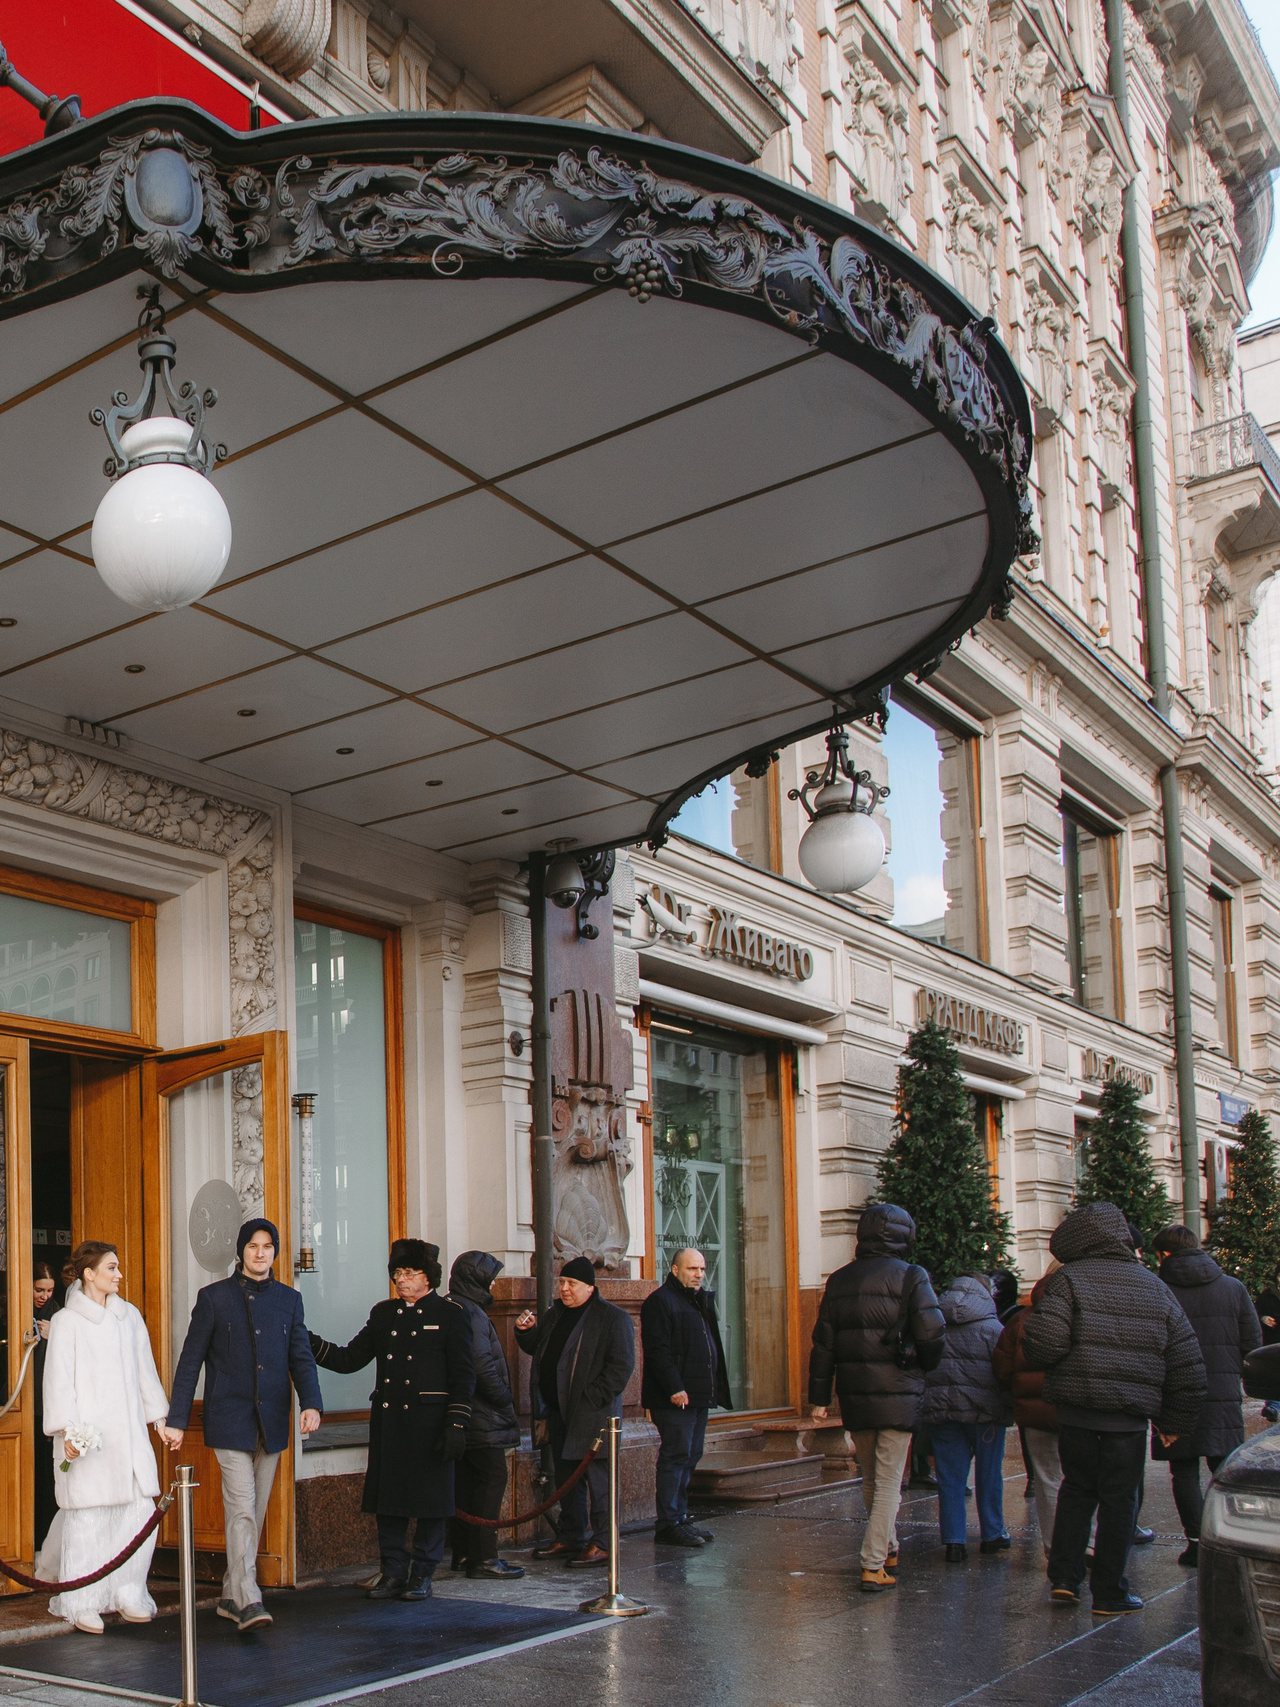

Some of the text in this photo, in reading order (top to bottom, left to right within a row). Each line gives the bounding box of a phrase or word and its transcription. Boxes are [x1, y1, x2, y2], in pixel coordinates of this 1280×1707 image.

[707, 905, 814, 981] Живаго
[918, 987, 1024, 1055] ГРАНД КАФЕ
[669, 1235, 710, 1249] NATIONAL
